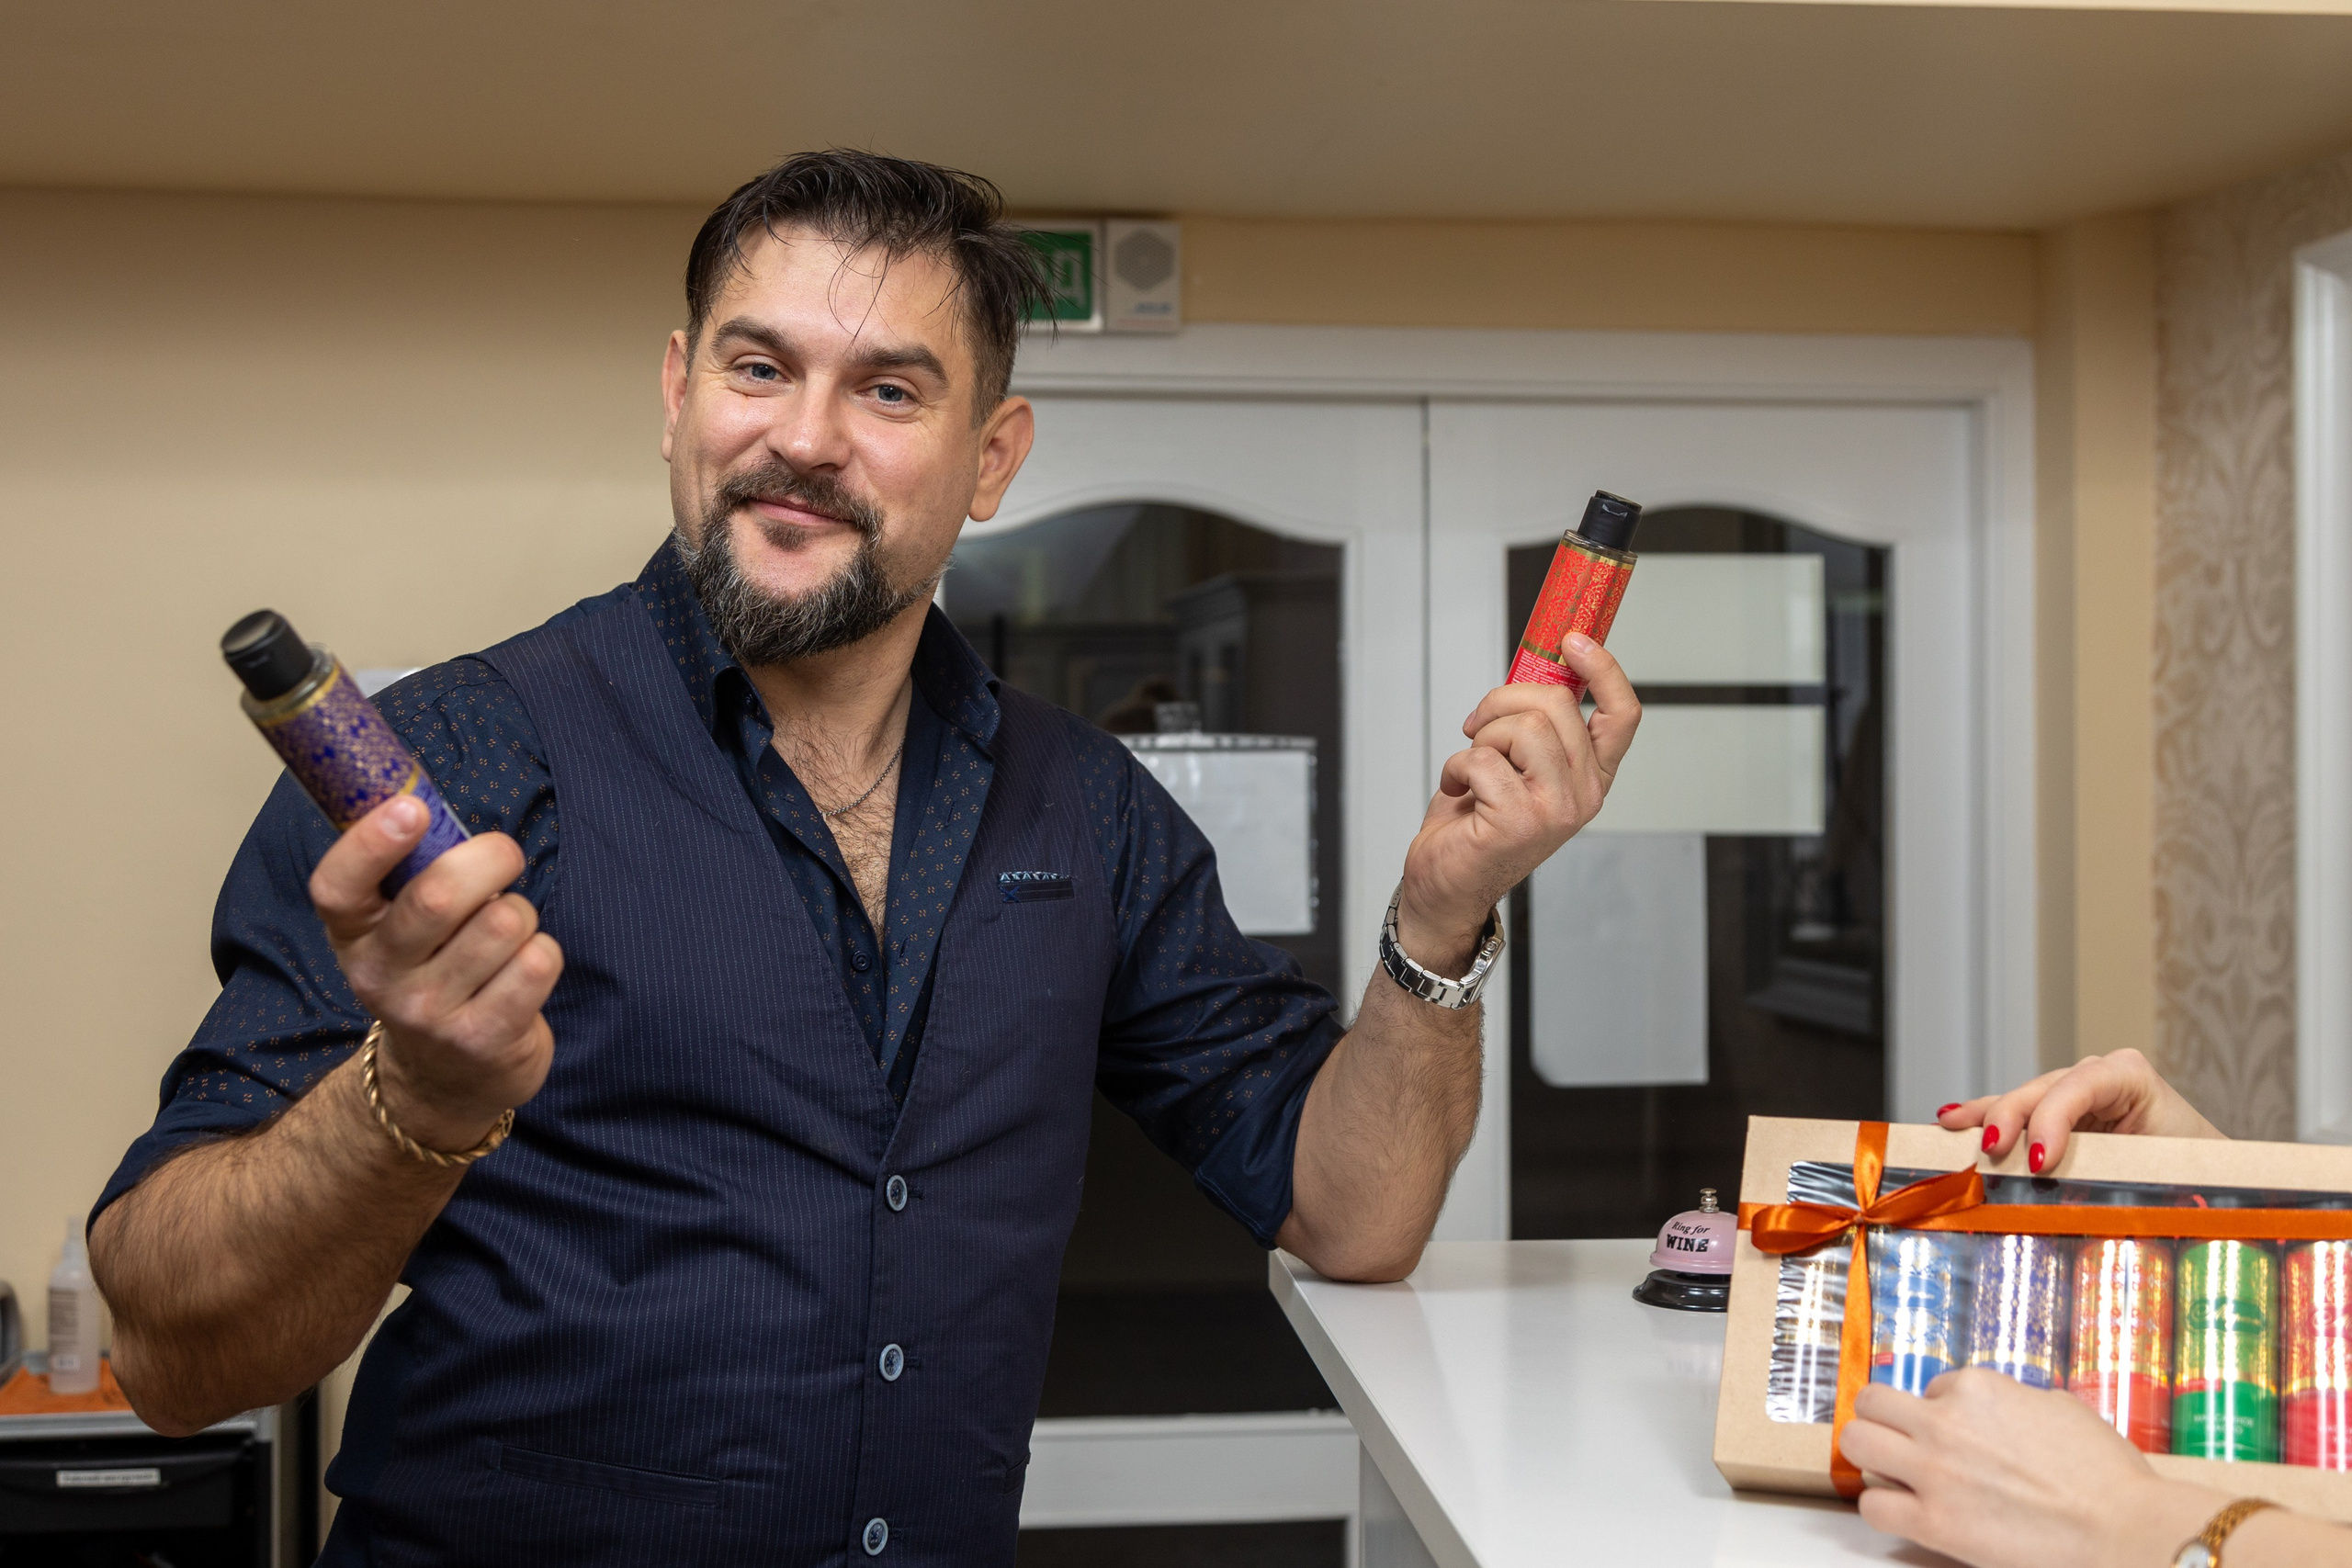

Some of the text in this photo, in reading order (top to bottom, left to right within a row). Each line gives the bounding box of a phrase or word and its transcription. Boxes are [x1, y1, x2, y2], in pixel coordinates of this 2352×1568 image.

[1671, 1221, 1711, 1235] Ring for
[1666, 1233, 1710, 1253] WINE
